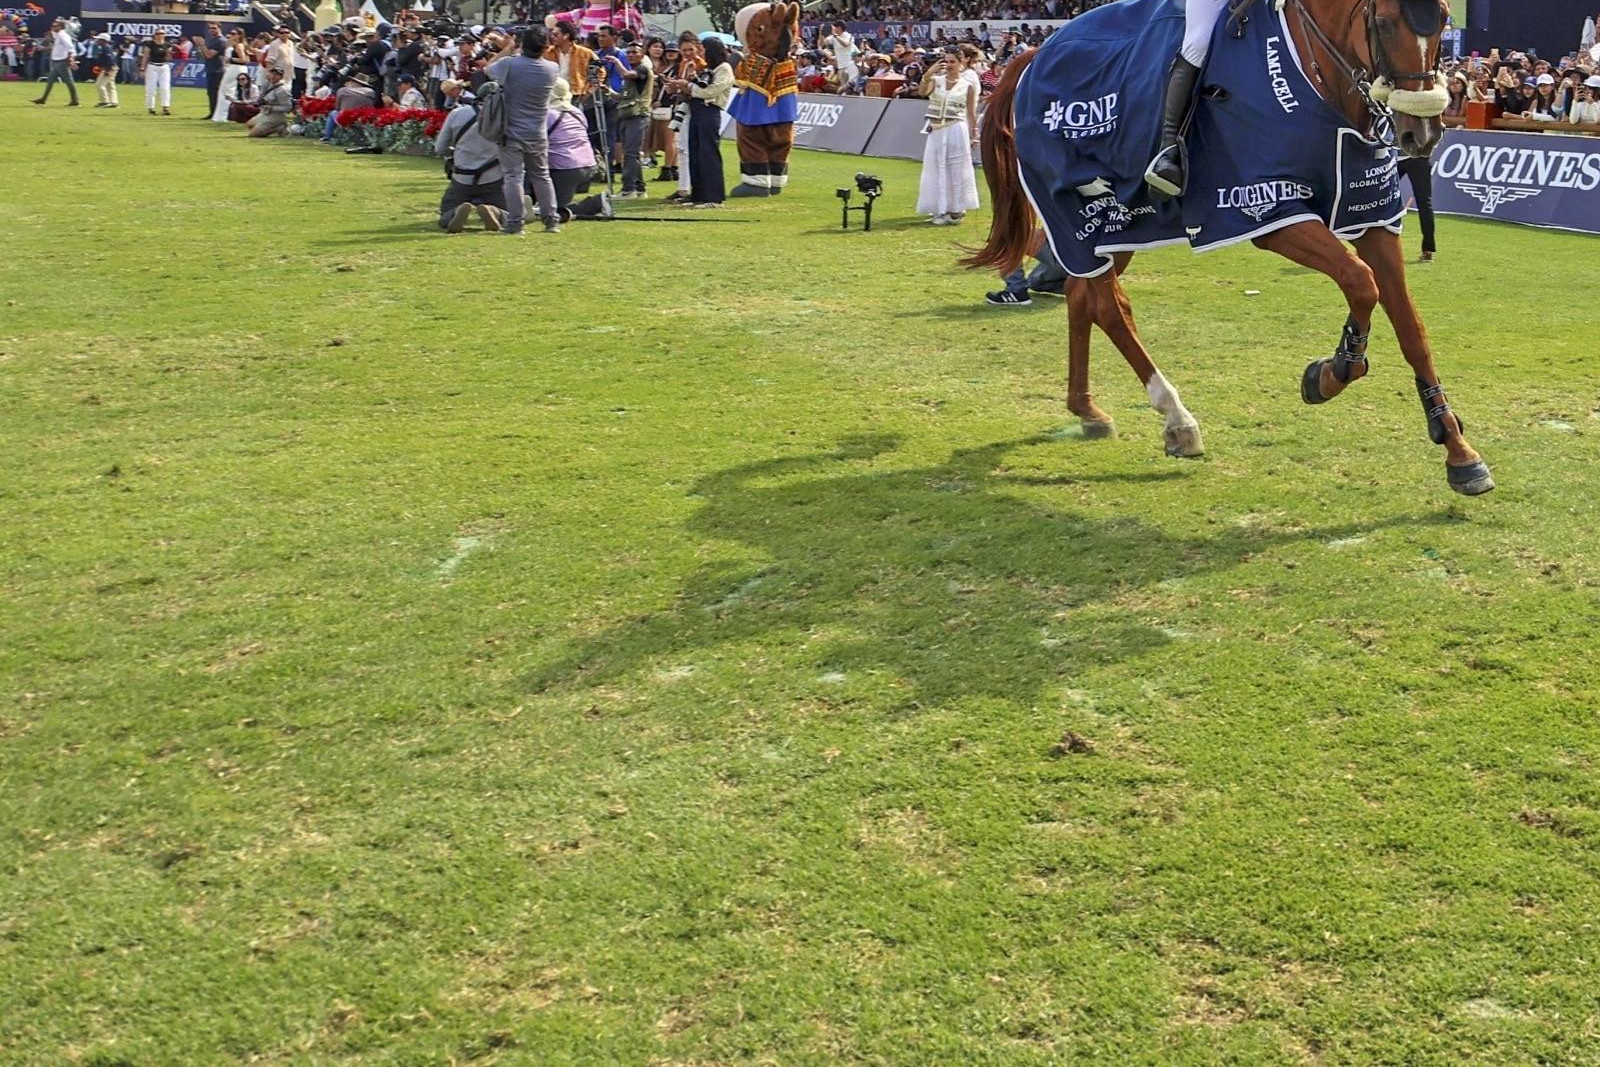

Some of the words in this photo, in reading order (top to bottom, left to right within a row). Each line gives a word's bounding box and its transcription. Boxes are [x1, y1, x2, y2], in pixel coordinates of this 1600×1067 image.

[106, 22, 182, 37] LONGINES
[1266, 36, 1299, 114] LAMI-CELL
[1064, 92, 1118, 127] GNP
[1217, 180, 1314, 208] LONGINES
[1349, 178, 1379, 189] GLOBAL
[1347, 200, 1378, 212] MEXICO
